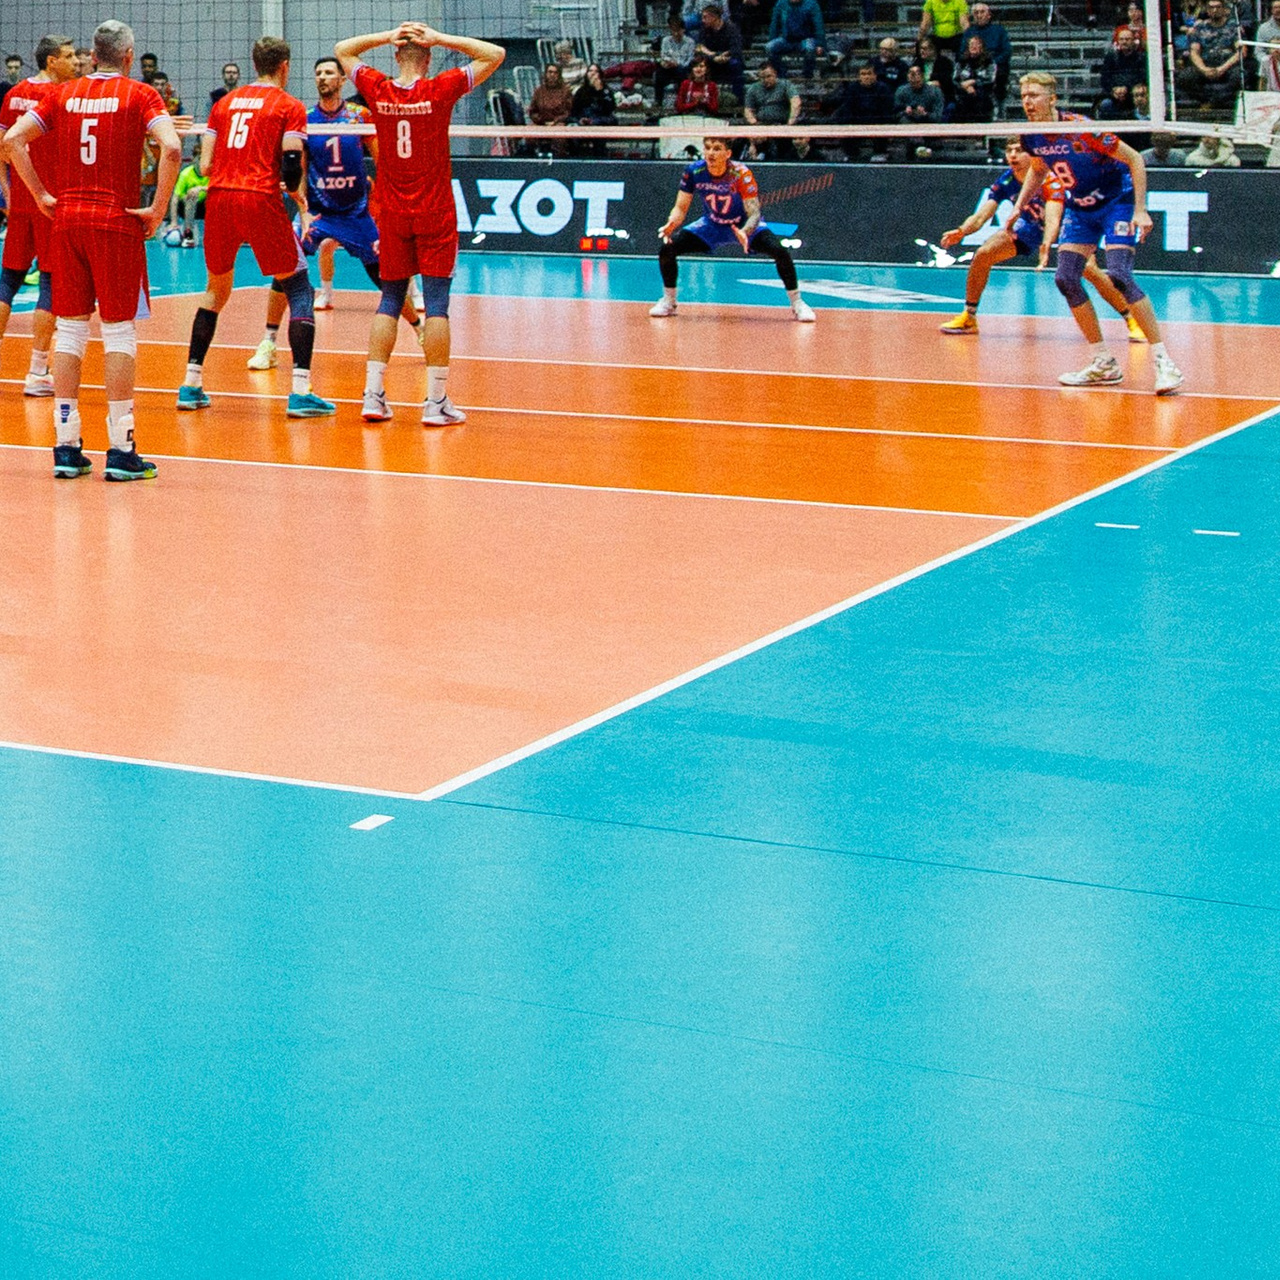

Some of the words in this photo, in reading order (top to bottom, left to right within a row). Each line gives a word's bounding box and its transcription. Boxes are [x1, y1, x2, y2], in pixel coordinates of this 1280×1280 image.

[80, 118, 98, 165] 5
[226, 112, 253, 150] 15
[325, 136, 341, 163] 1
[396, 120, 412, 159] 8
[316, 176, 357, 189] АЗОТ
[705, 193, 732, 214] 17
[960, 188, 1208, 251] АТ
